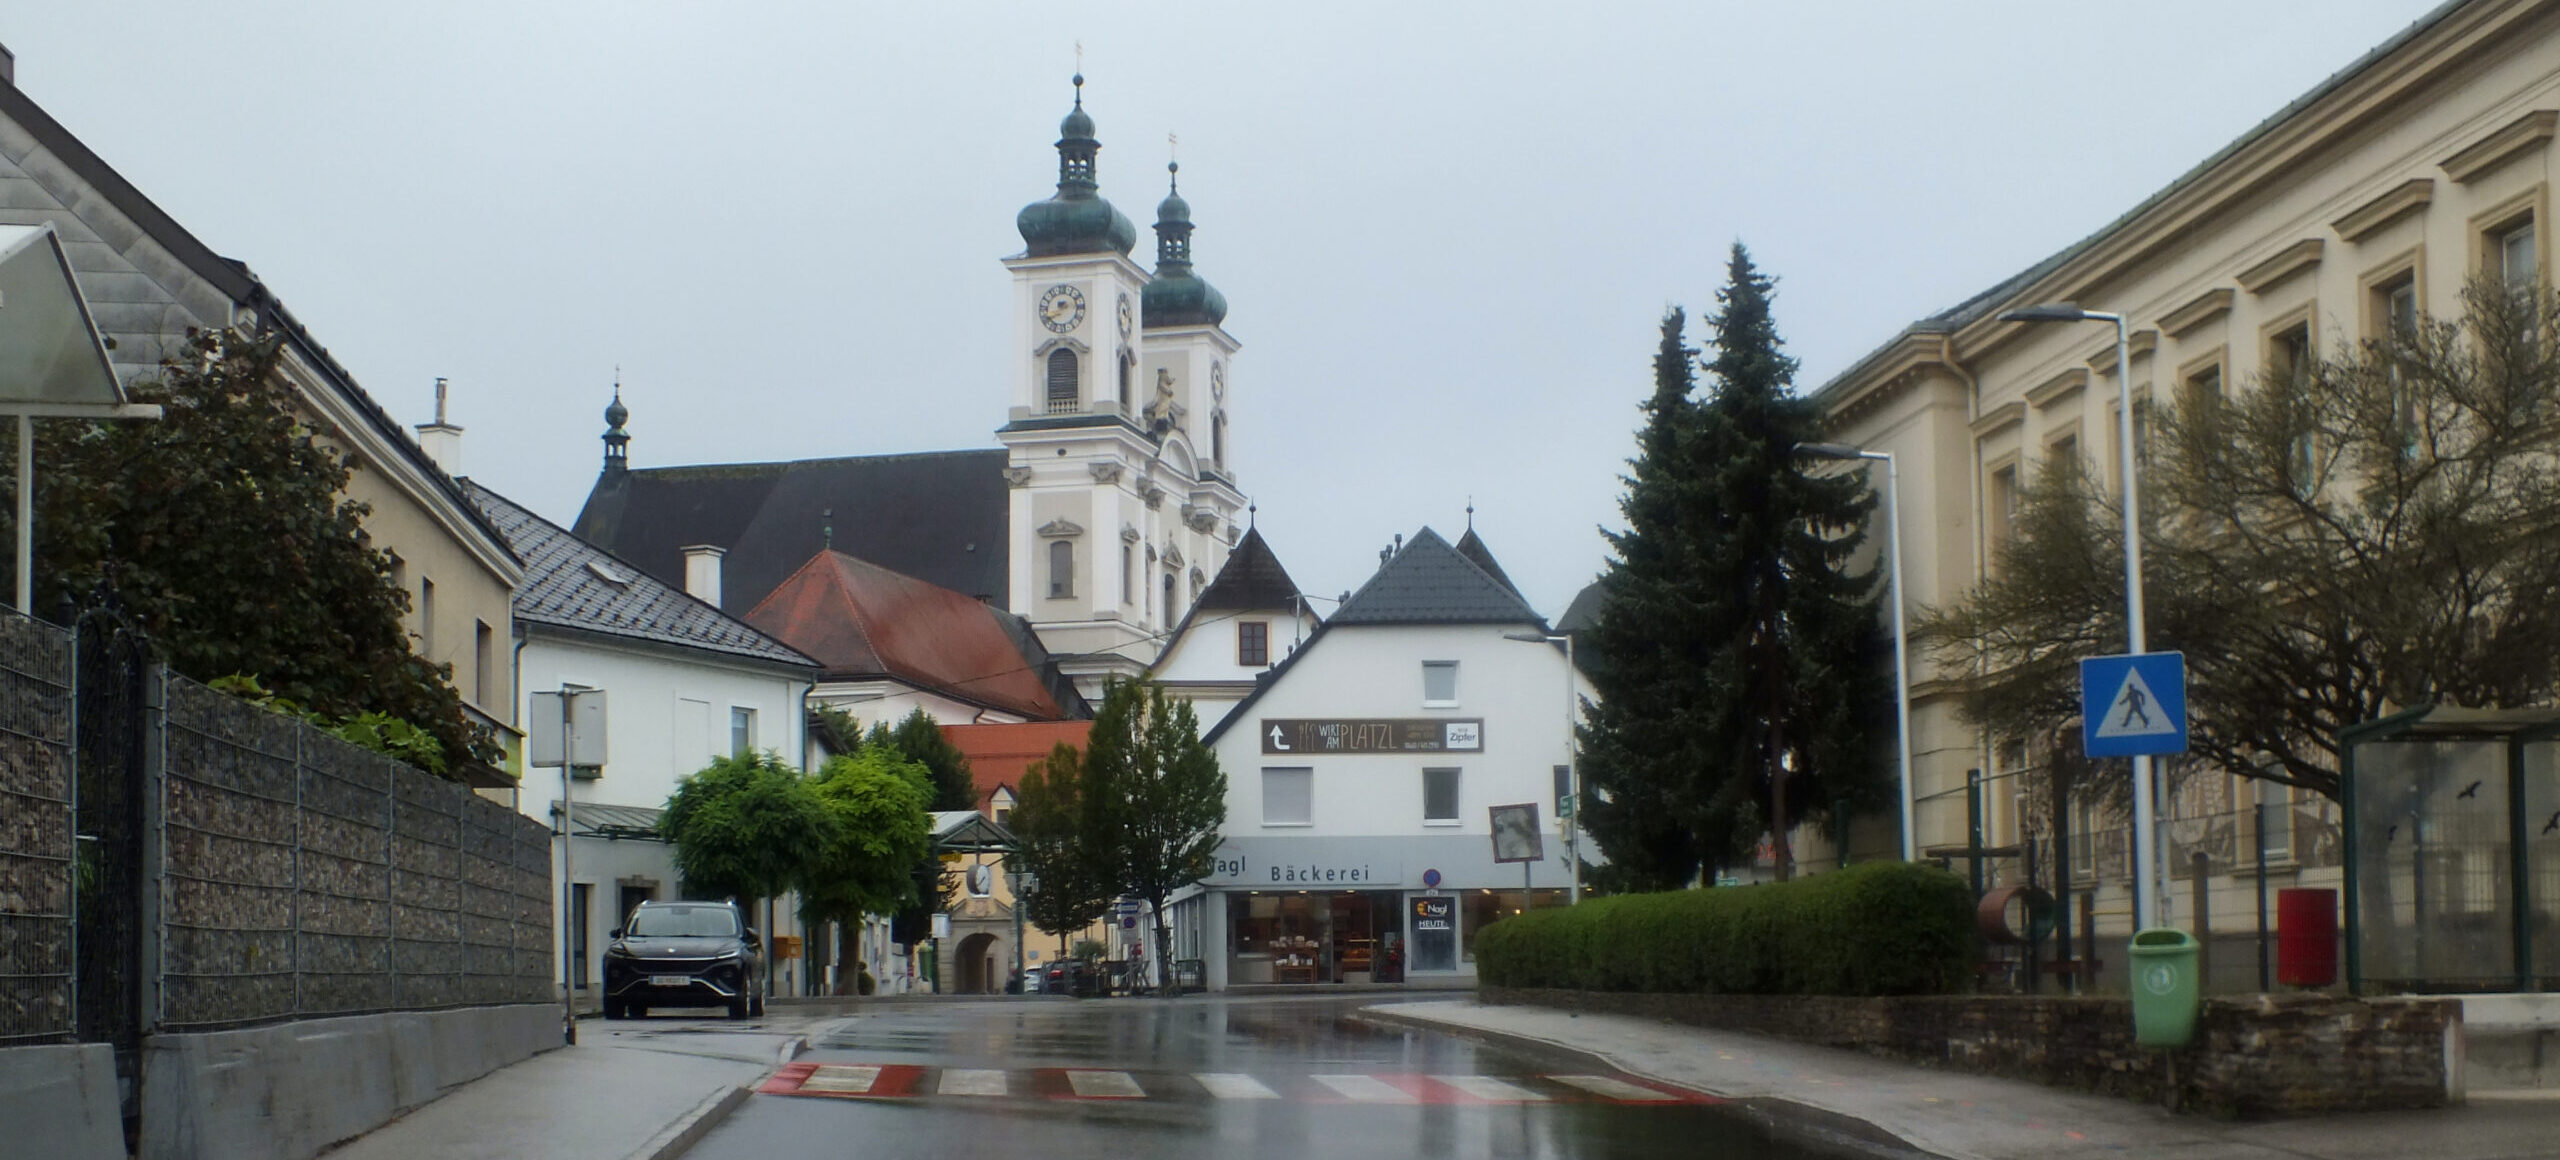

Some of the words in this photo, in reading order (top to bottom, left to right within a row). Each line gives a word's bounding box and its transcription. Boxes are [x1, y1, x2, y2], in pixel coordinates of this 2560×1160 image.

[1319, 724, 1340, 736] WIRT
[1326, 736, 1340, 749] AM
[1341, 724, 1398, 750] PLATZL
[1271, 864, 1369, 882] Bäckerei
[1427, 903, 1448, 915] Nagl
